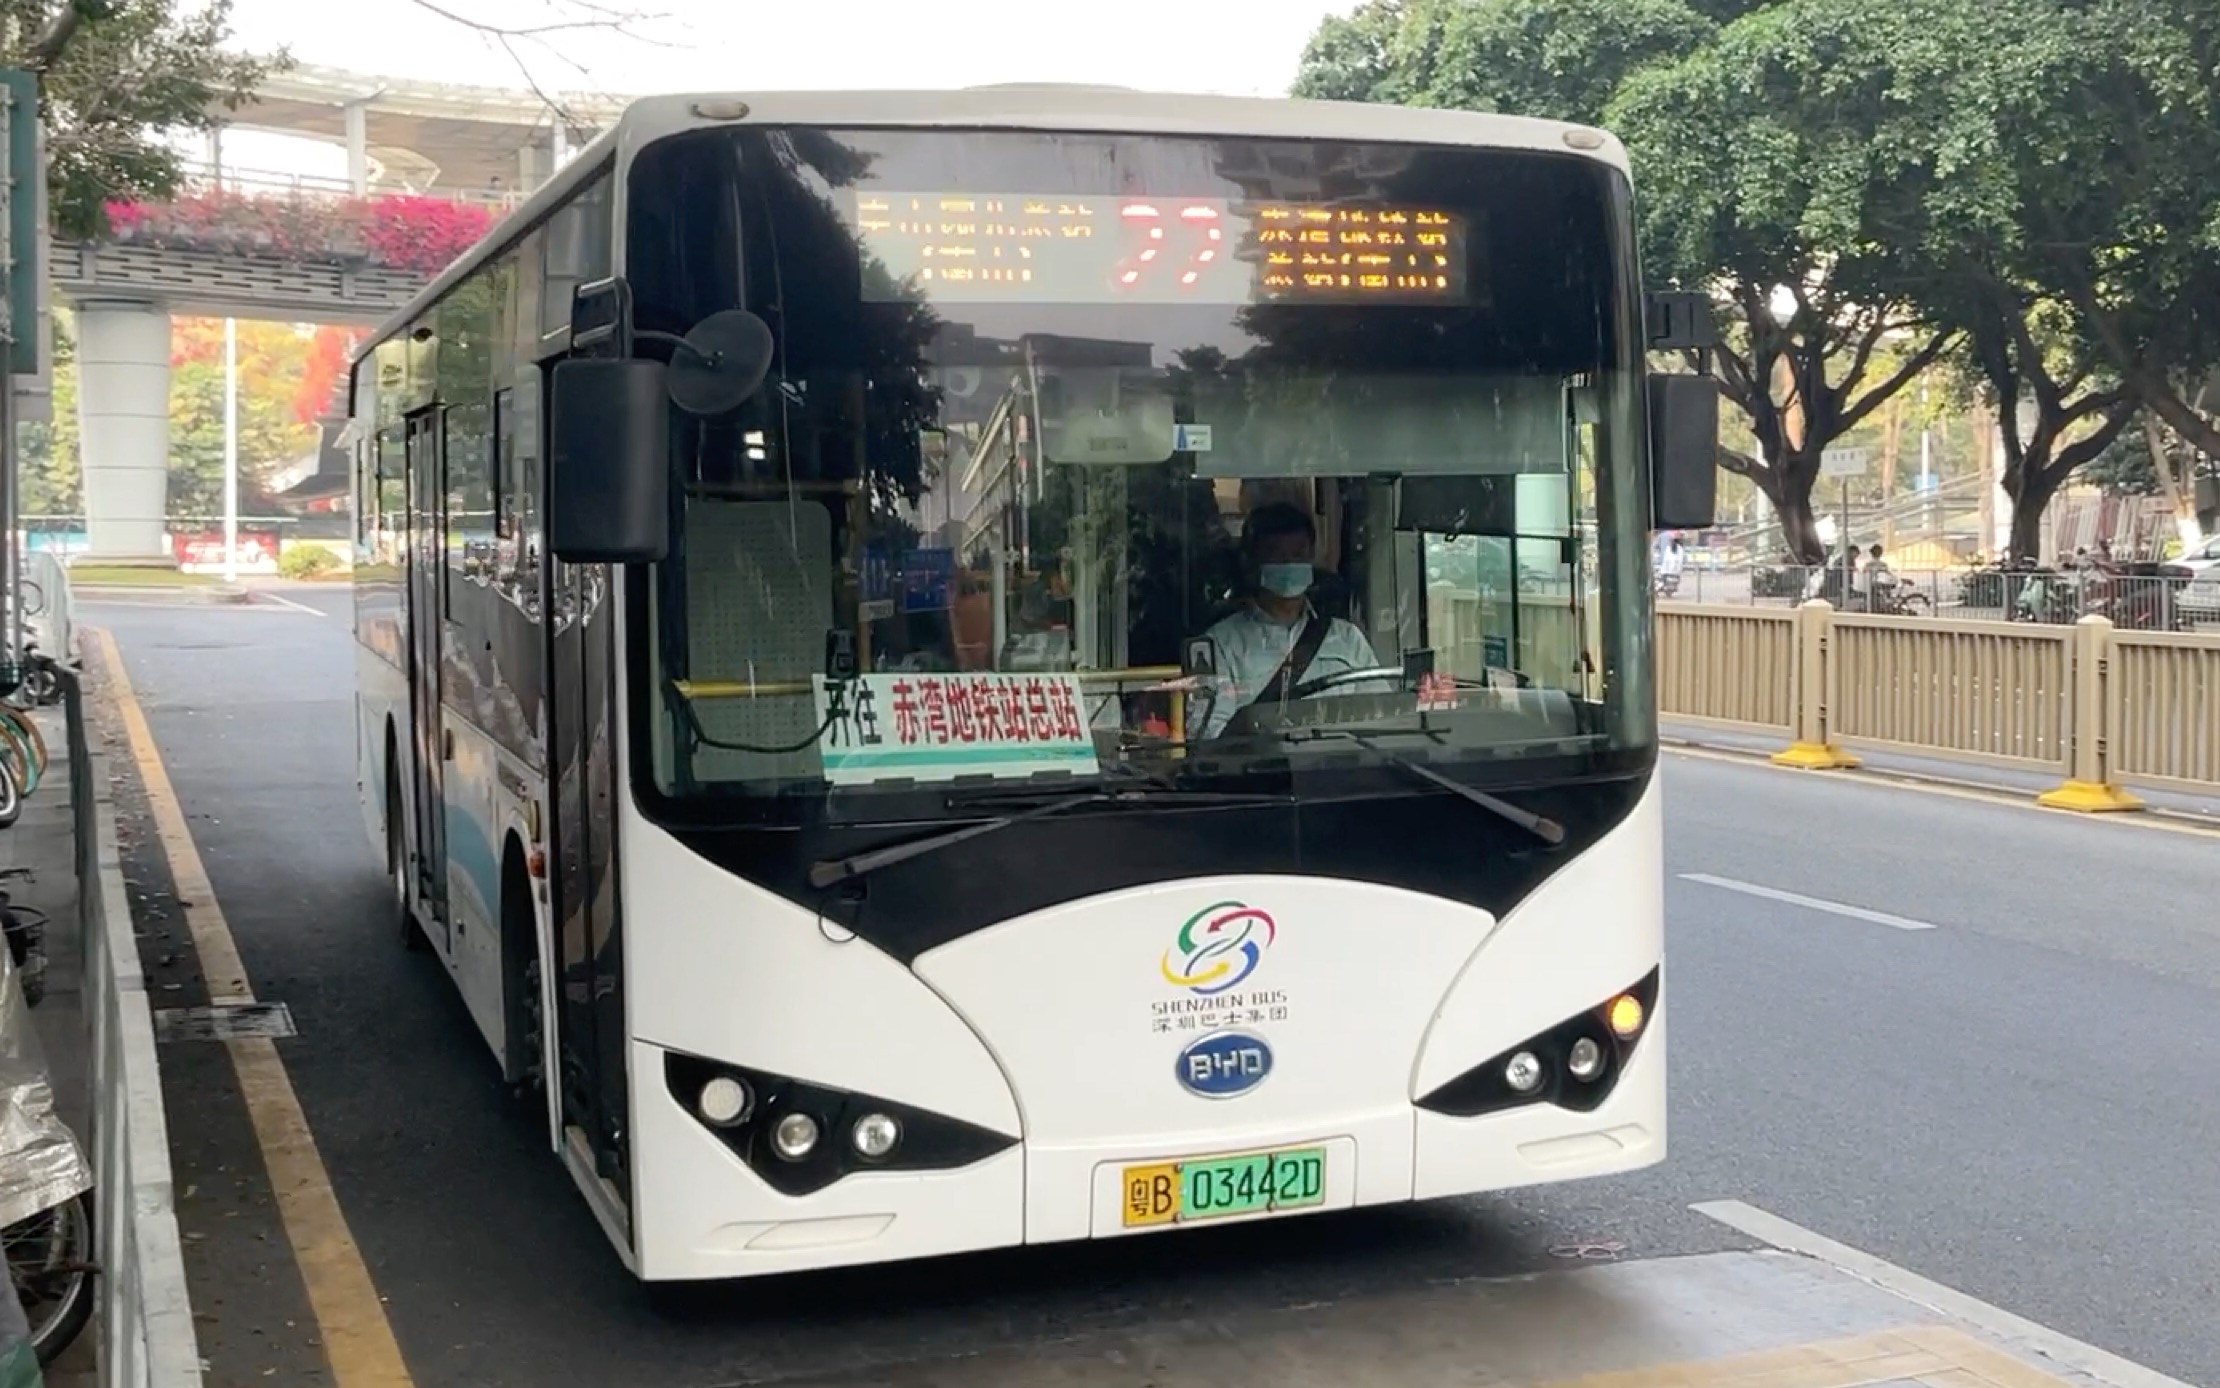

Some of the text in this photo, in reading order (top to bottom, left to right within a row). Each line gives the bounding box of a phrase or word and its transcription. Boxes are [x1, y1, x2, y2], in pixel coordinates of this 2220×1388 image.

[823, 676, 1083, 747] 开往 赤湾地铁站总站
[1151, 991, 1287, 1016] SHENZHEN BUS
[1152, 1006, 1288, 1034] 深圳巴士集团
[1188, 1047, 1262, 1081] BYD
[1130, 1157, 1321, 1217] 粤B 03442D
